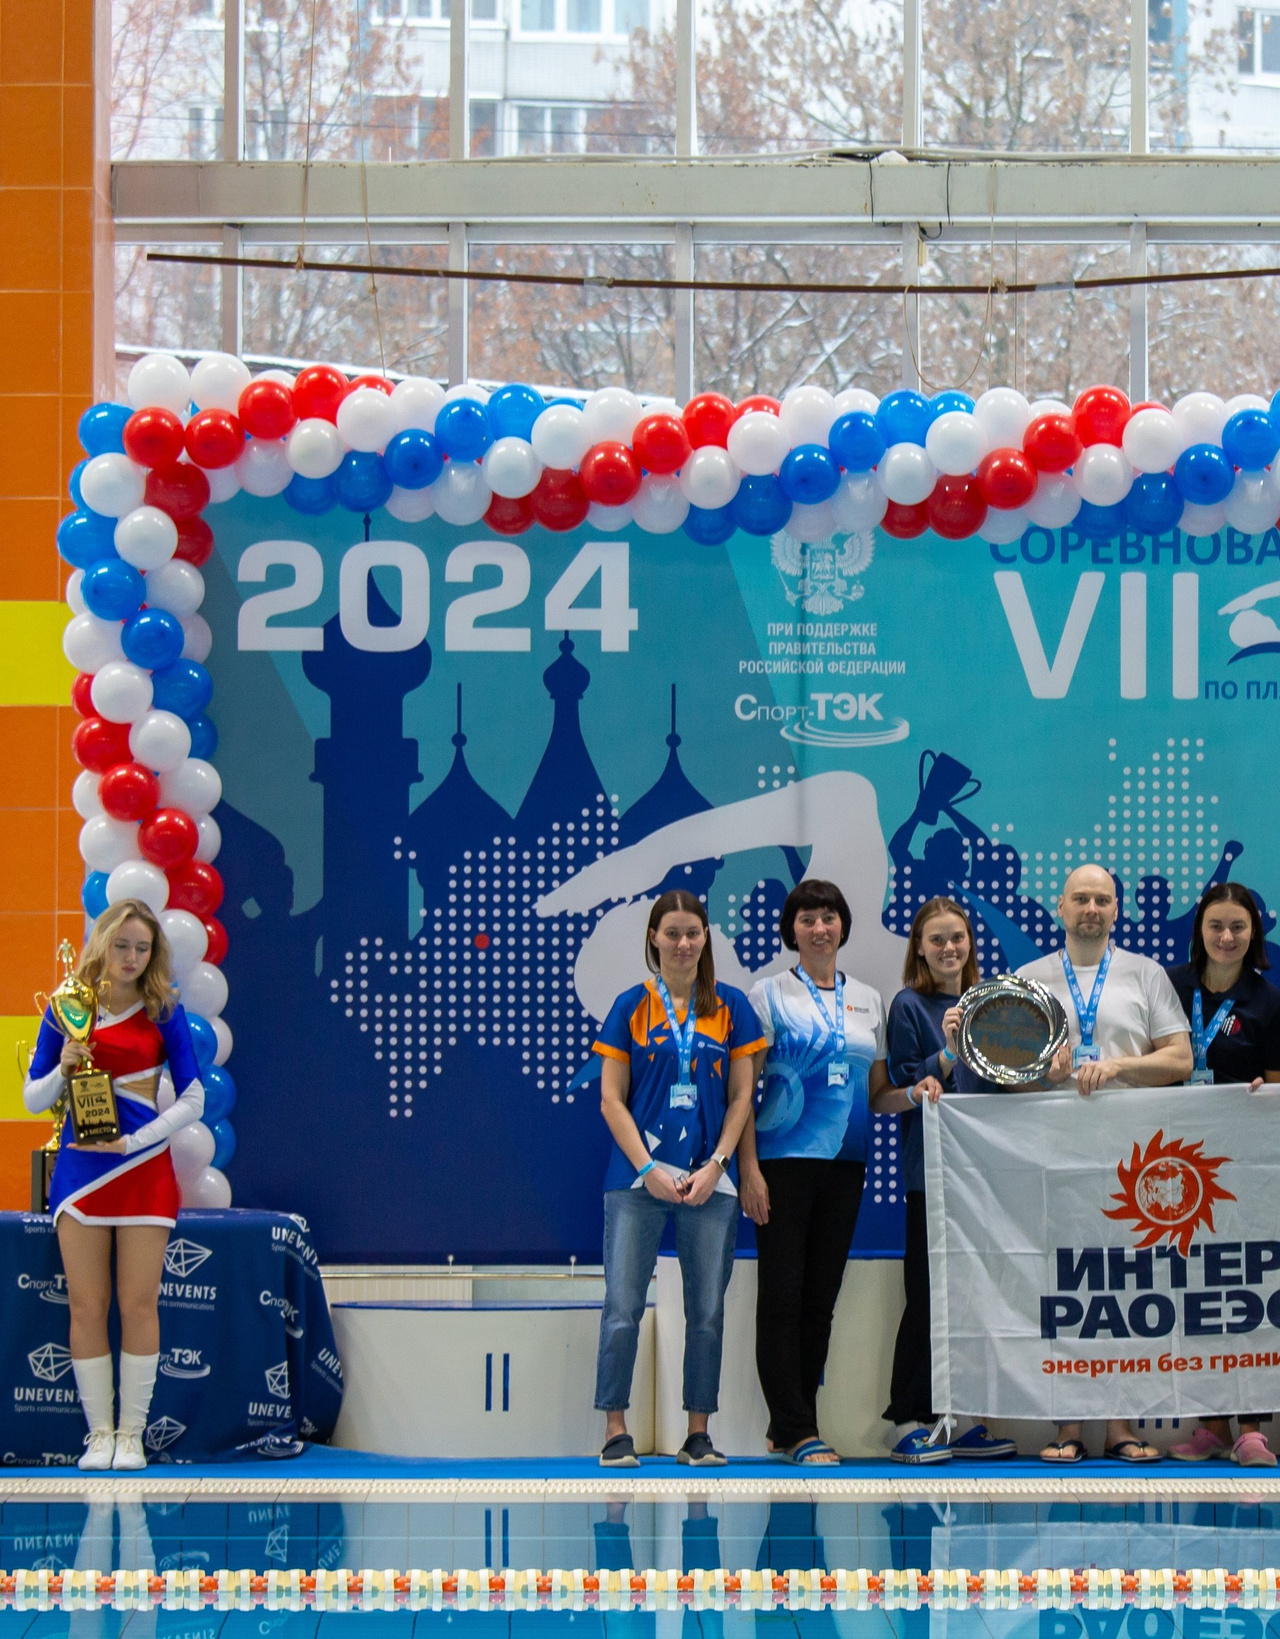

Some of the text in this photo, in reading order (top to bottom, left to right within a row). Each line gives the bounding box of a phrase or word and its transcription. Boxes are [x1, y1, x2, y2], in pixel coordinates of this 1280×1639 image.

[237, 540, 639, 652] 2024
[767, 623, 877, 638] ПРИ ПОДДЕРЖКЕ
[993, 571, 1199, 699] VII
[769, 642, 876, 655] ПРАВИТЕЛЬСТВА
[739, 659, 906, 676] РОССИЙСКОЙ ФЕДЕРАЦИИ
[1204, 680, 1239, 700] ПО
[159, 1282, 217, 1300] NEVENTS
[1042, 1356, 1152, 1379] энергия
[1157, 1352, 1203, 1374] без
[248, 1402, 291, 1418] UNEVE
